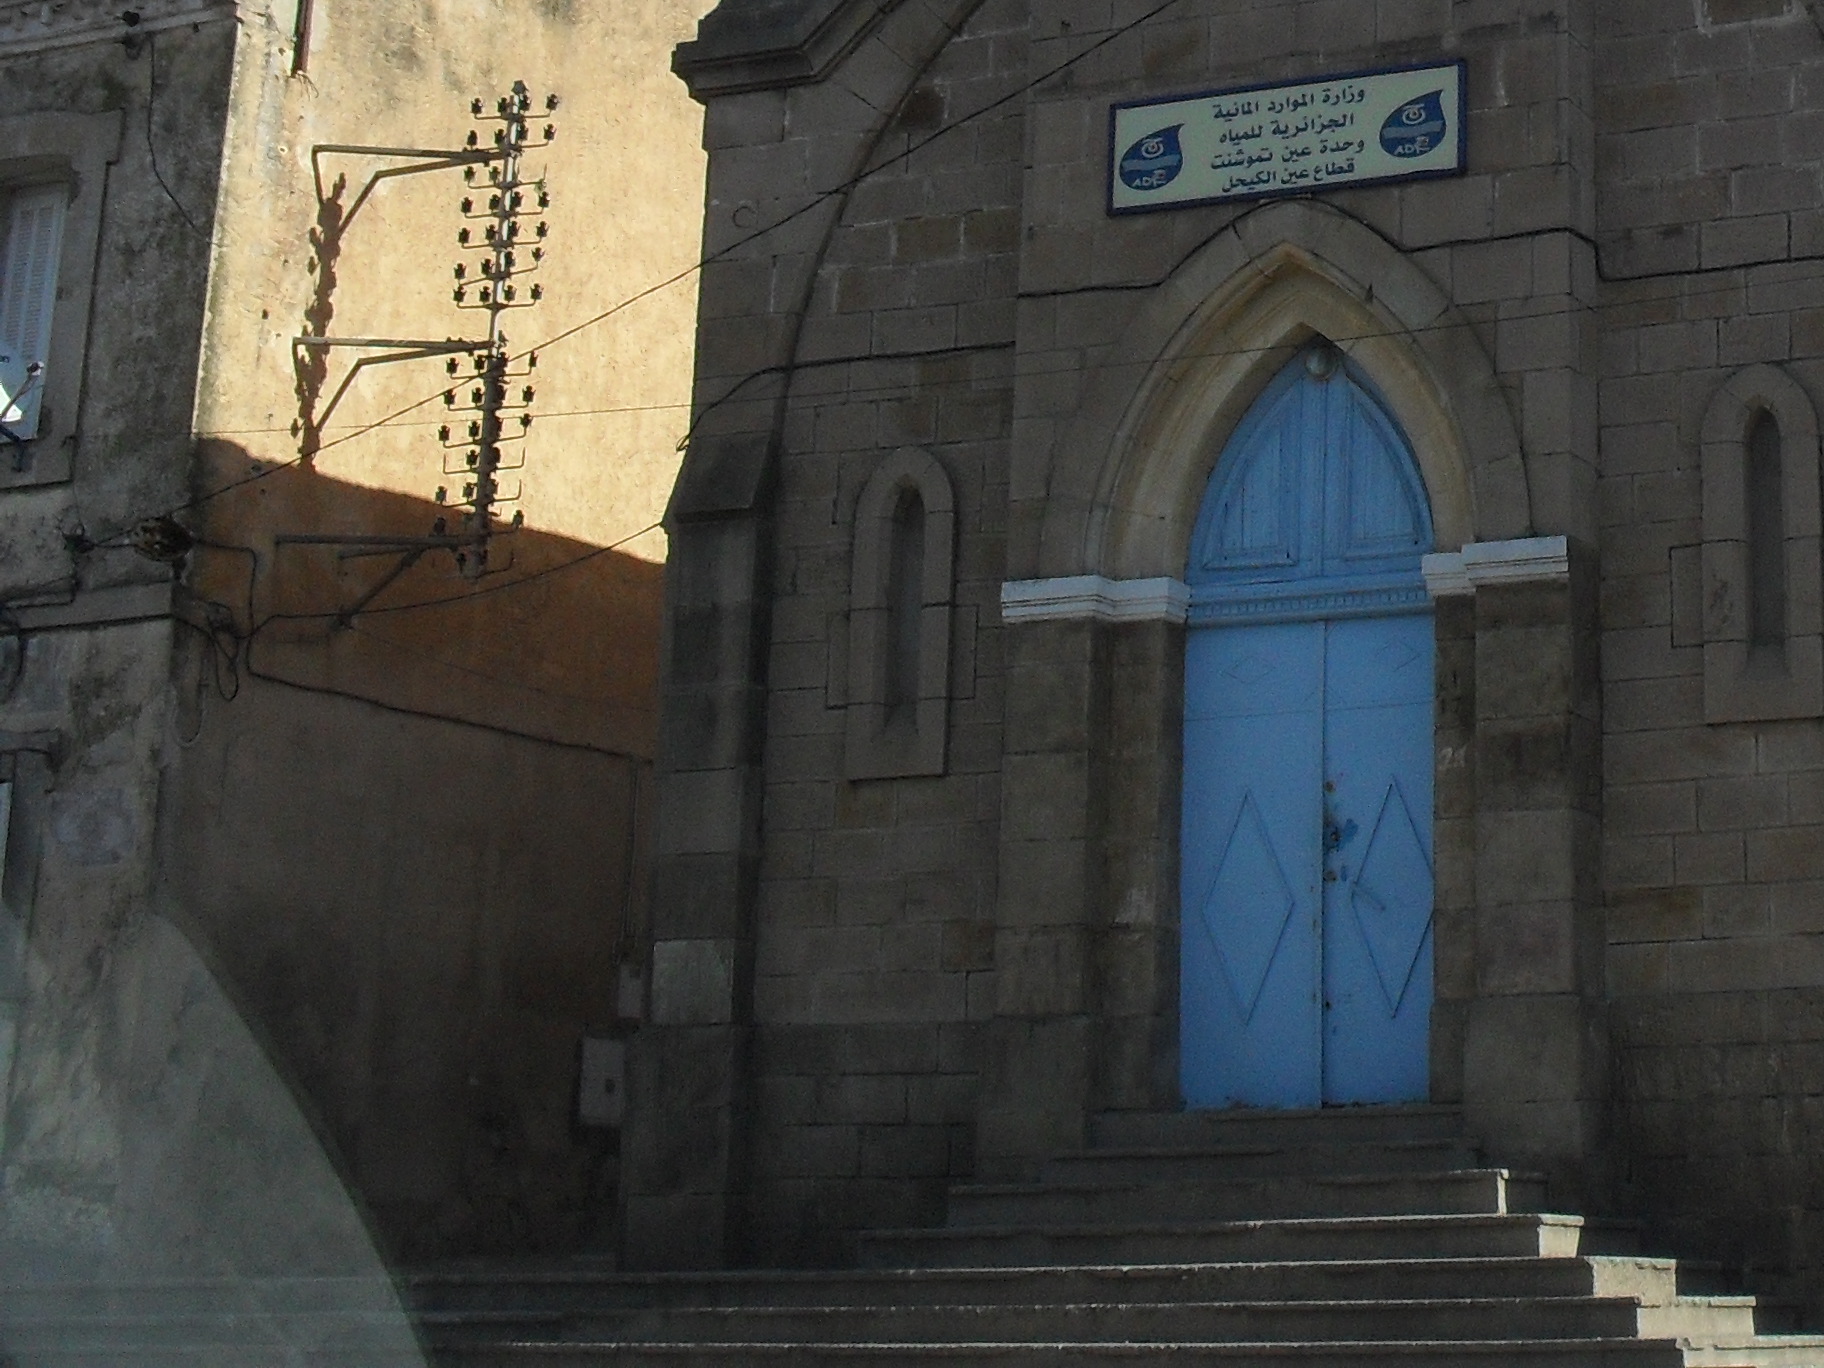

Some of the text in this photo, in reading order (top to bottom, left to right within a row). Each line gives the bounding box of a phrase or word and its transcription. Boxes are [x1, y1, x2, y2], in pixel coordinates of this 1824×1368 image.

[1267, 93, 1315, 114] الموارد
[1322, 85, 1366, 106] وزارة
[1219, 112, 1355, 146] الجزائرية للمياه
[1210, 139, 1365, 170] وحدة عين تموشنت
[1221, 157, 1355, 193] قطاع عين الكيحل
